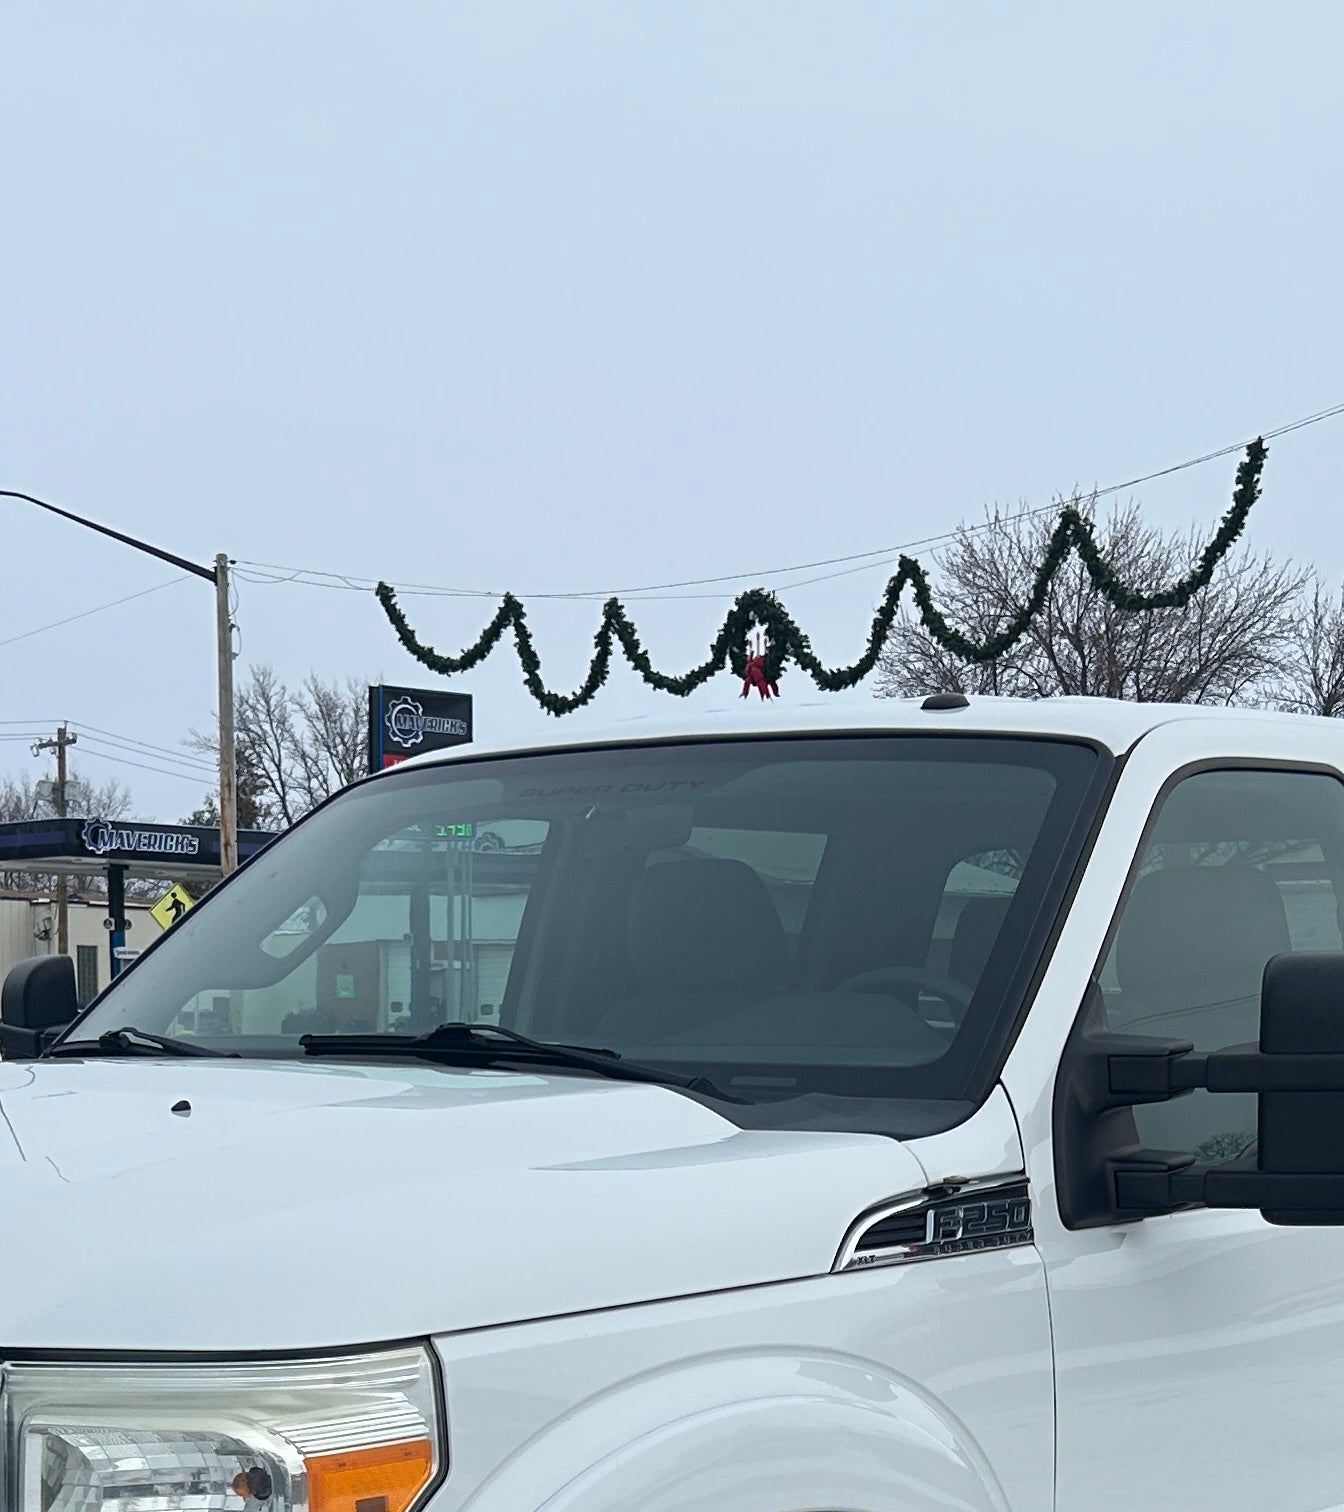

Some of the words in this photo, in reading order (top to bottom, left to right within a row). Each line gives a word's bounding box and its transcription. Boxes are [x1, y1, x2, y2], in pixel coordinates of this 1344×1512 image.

[518, 783, 614, 798] SUPER
[620, 780, 707, 794] DUTY
[857, 1255, 876, 1265] XLT
